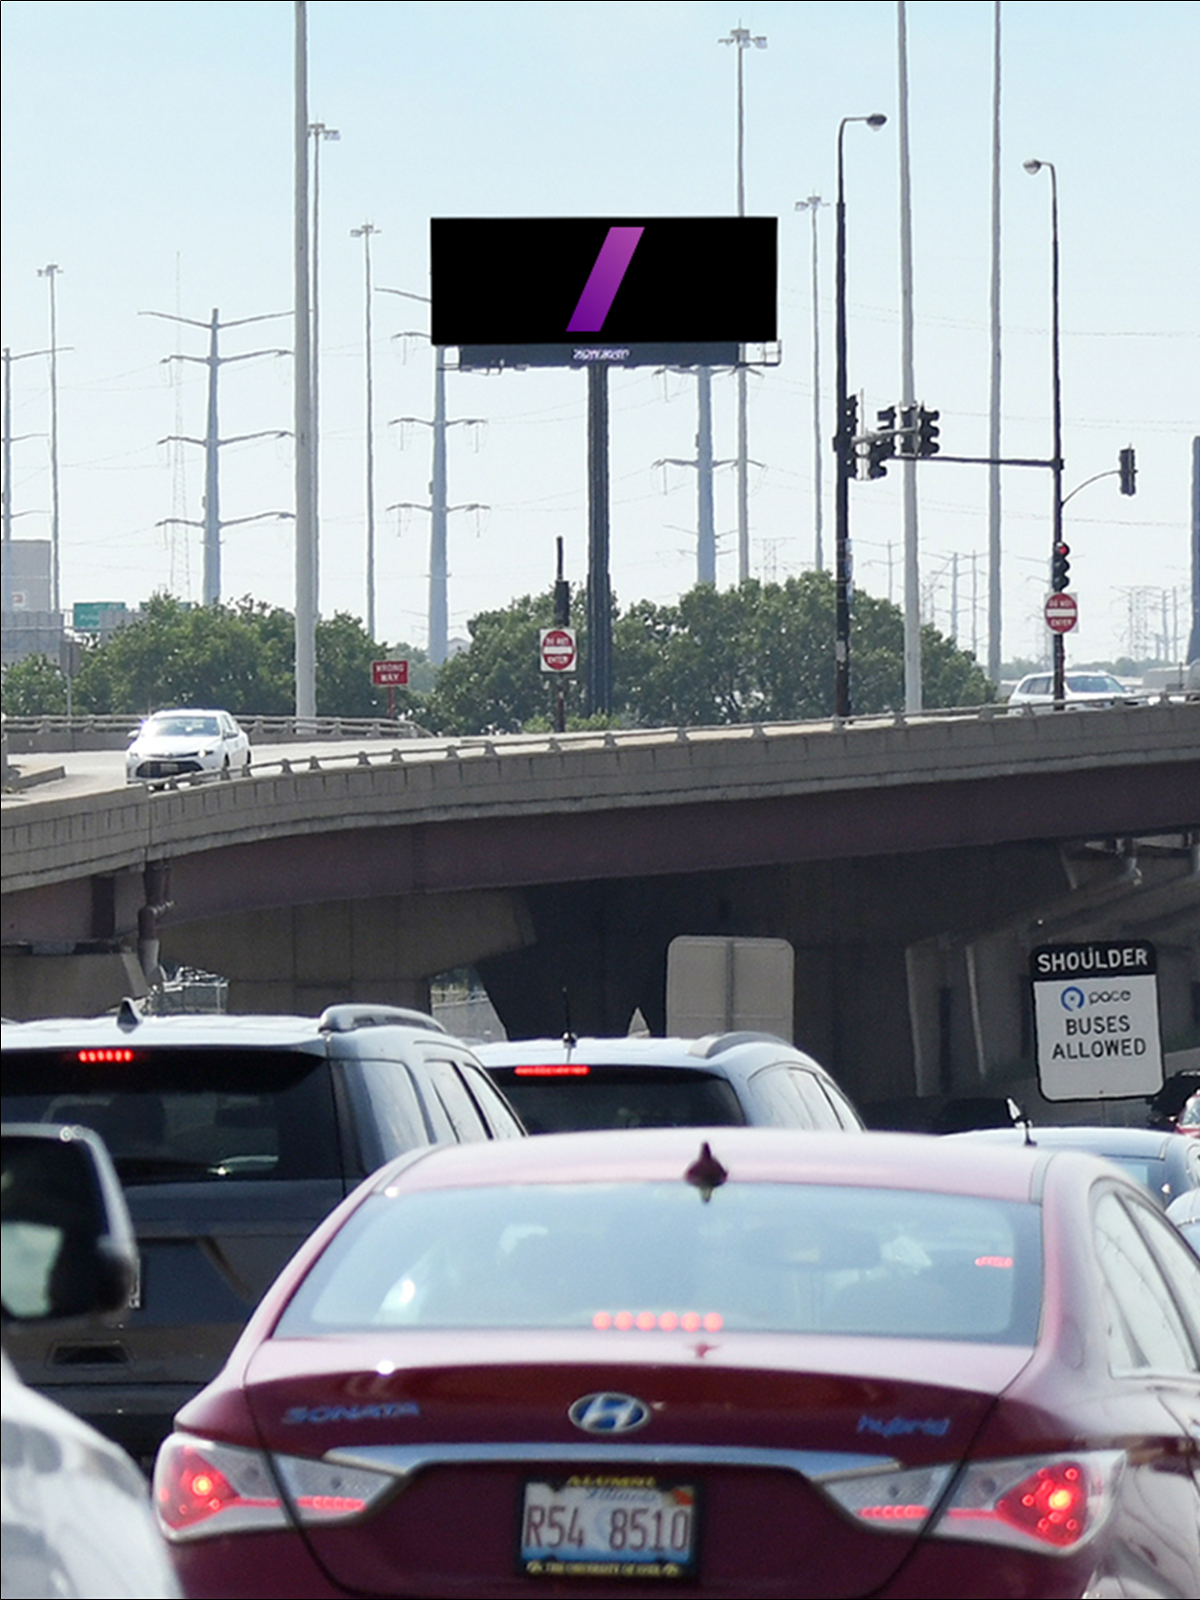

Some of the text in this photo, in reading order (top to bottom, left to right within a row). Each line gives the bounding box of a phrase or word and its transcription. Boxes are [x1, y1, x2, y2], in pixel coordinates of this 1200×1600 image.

[1051, 619, 1072, 627] ENTER
[375, 663, 404, 672] WRONG
[547, 656, 569, 664] ENTER
[381, 674, 399, 682] WAY
[1037, 948, 1148, 973] SHOULDER
[1088, 990, 1132, 1006] pace
[1065, 1015, 1131, 1036] BUSES
[1052, 1038, 1147, 1060] ALLOWED
[284, 1402, 418, 1423] SONATA
[857, 1416, 950, 1438] hybrid
[525, 1505, 690, 1551] R54 8510
